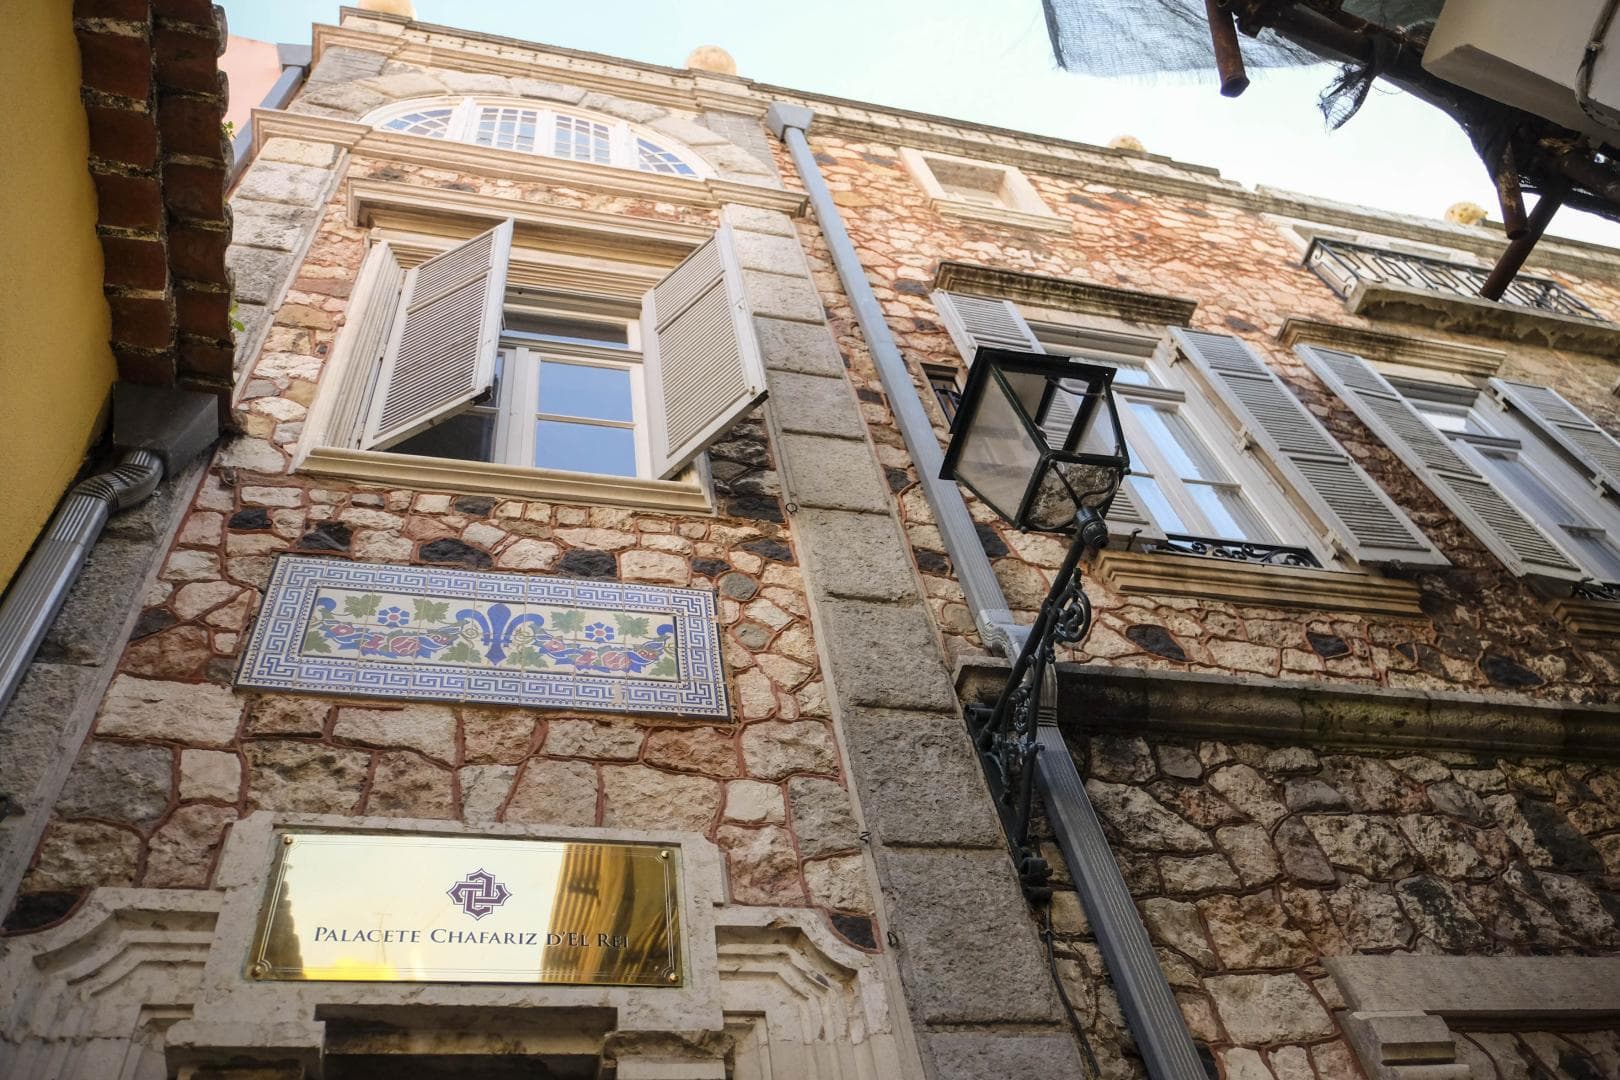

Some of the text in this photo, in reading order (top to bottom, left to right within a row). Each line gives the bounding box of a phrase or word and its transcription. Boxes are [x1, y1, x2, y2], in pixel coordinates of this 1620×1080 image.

[314, 926, 421, 943] PALACETE
[430, 928, 538, 945] CHAFARIZ
[597, 932, 630, 948] REI
